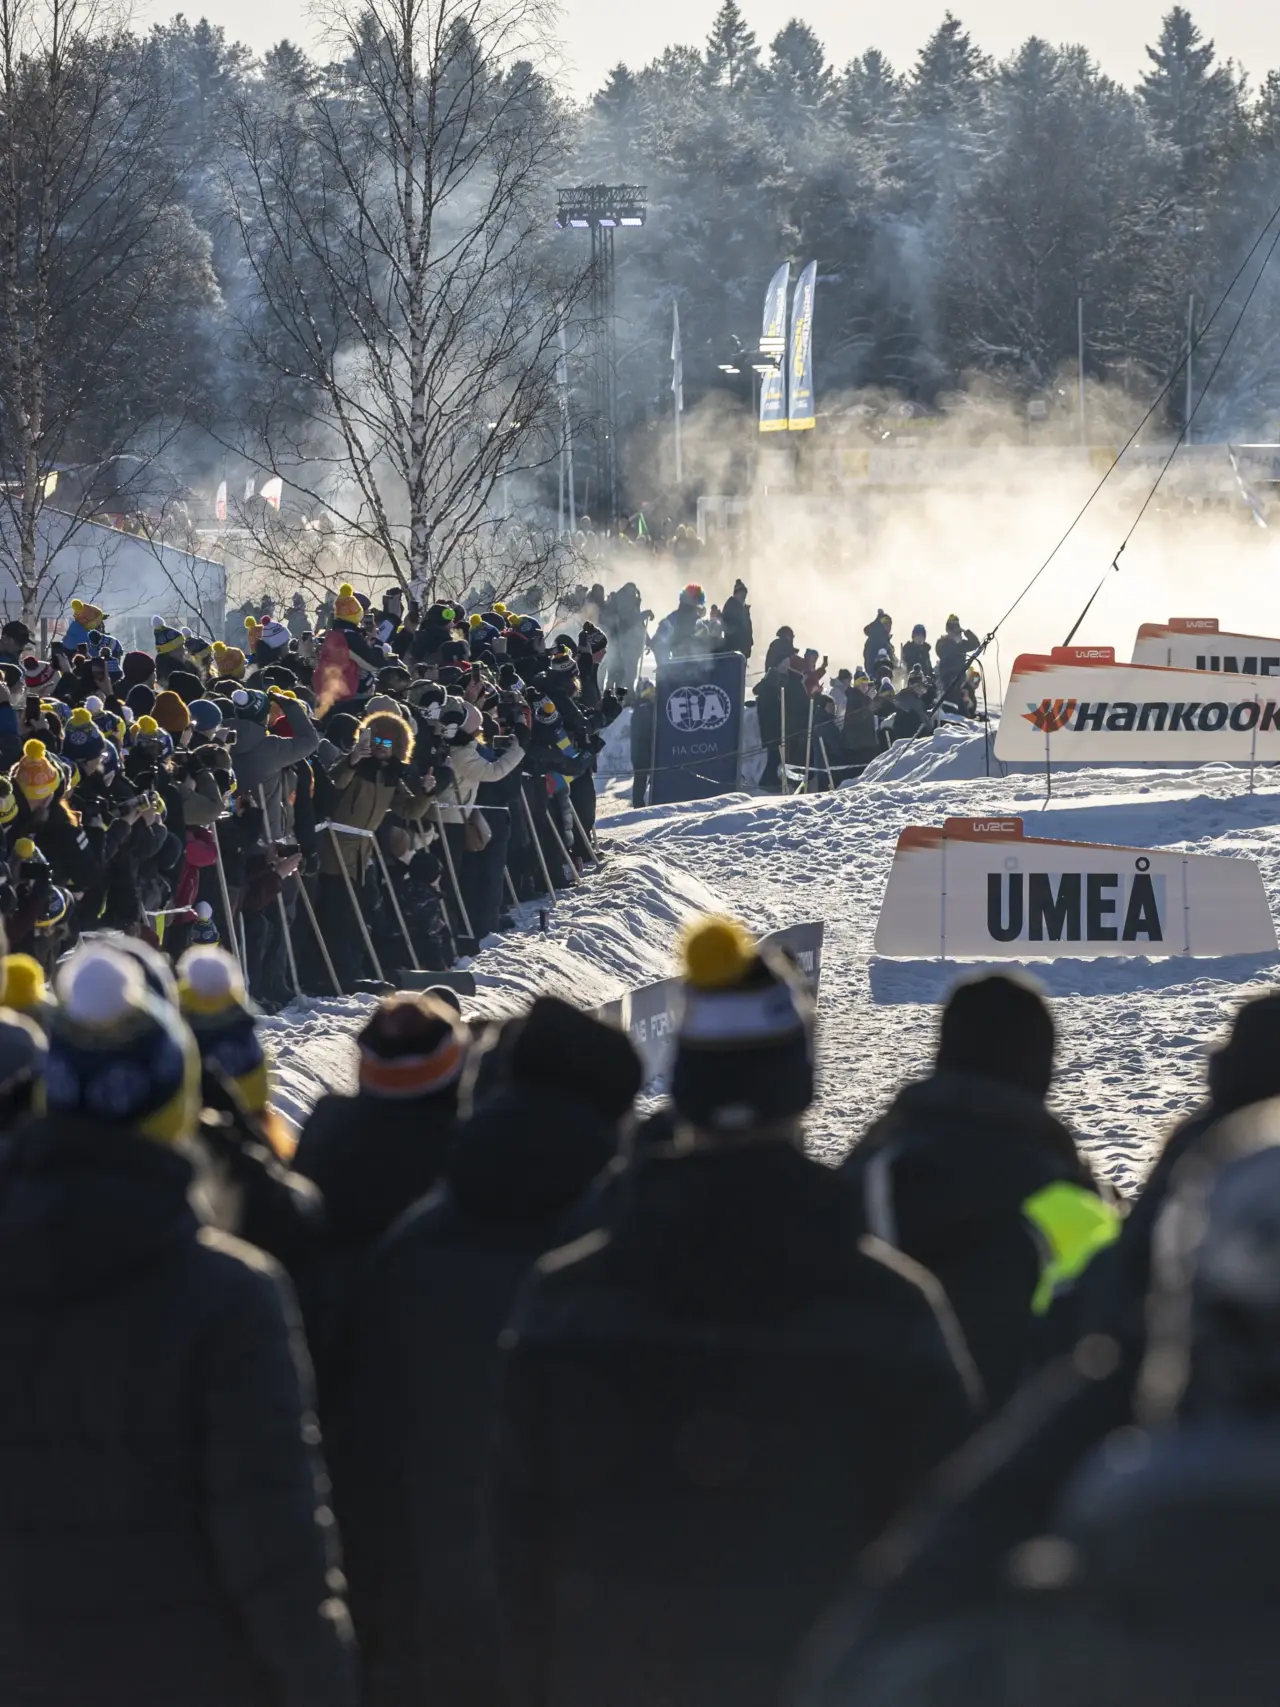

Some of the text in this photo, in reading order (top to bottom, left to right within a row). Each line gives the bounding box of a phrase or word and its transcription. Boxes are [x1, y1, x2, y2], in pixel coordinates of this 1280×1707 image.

[1186, 620, 1214, 628] WRC
[1076, 650, 1110, 659] WRC
[973, 822, 1015, 832] WRC
[987, 857, 1163, 942] UMEÅ
